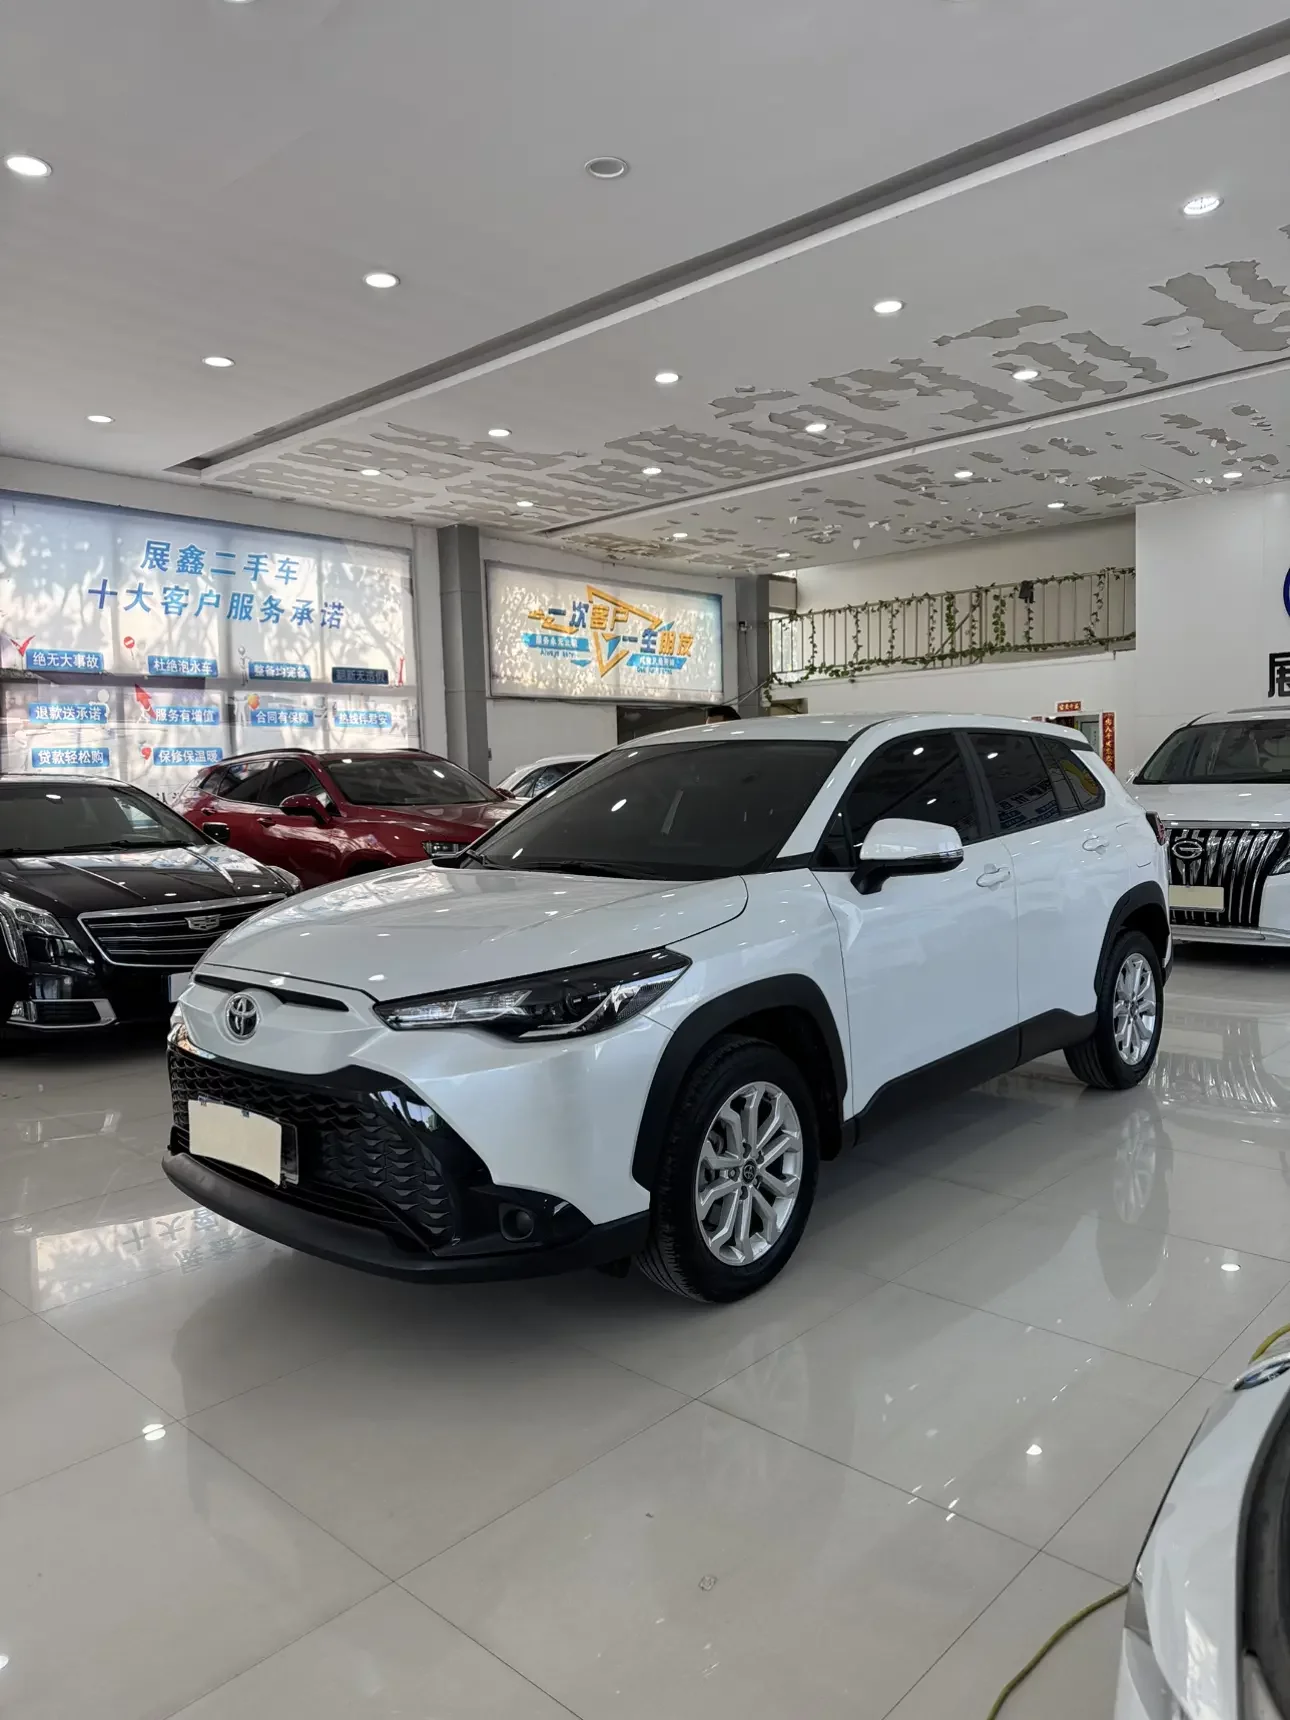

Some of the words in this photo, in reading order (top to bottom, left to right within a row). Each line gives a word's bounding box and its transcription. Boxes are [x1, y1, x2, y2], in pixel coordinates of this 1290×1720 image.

[140, 539, 300, 585] 展鑫二手车
[88, 579, 345, 629] 十大客户服务承诺
[33, 652, 99, 669] 绝无大事故
[154, 660, 213, 674] 杜绝泡水车
[36, 705, 102, 721] 退款送承诺
[155, 708, 215, 722] 服务有增值
[38, 750, 104, 765] 贷款轻松购
[159, 750, 218, 763] 保修保温暖
